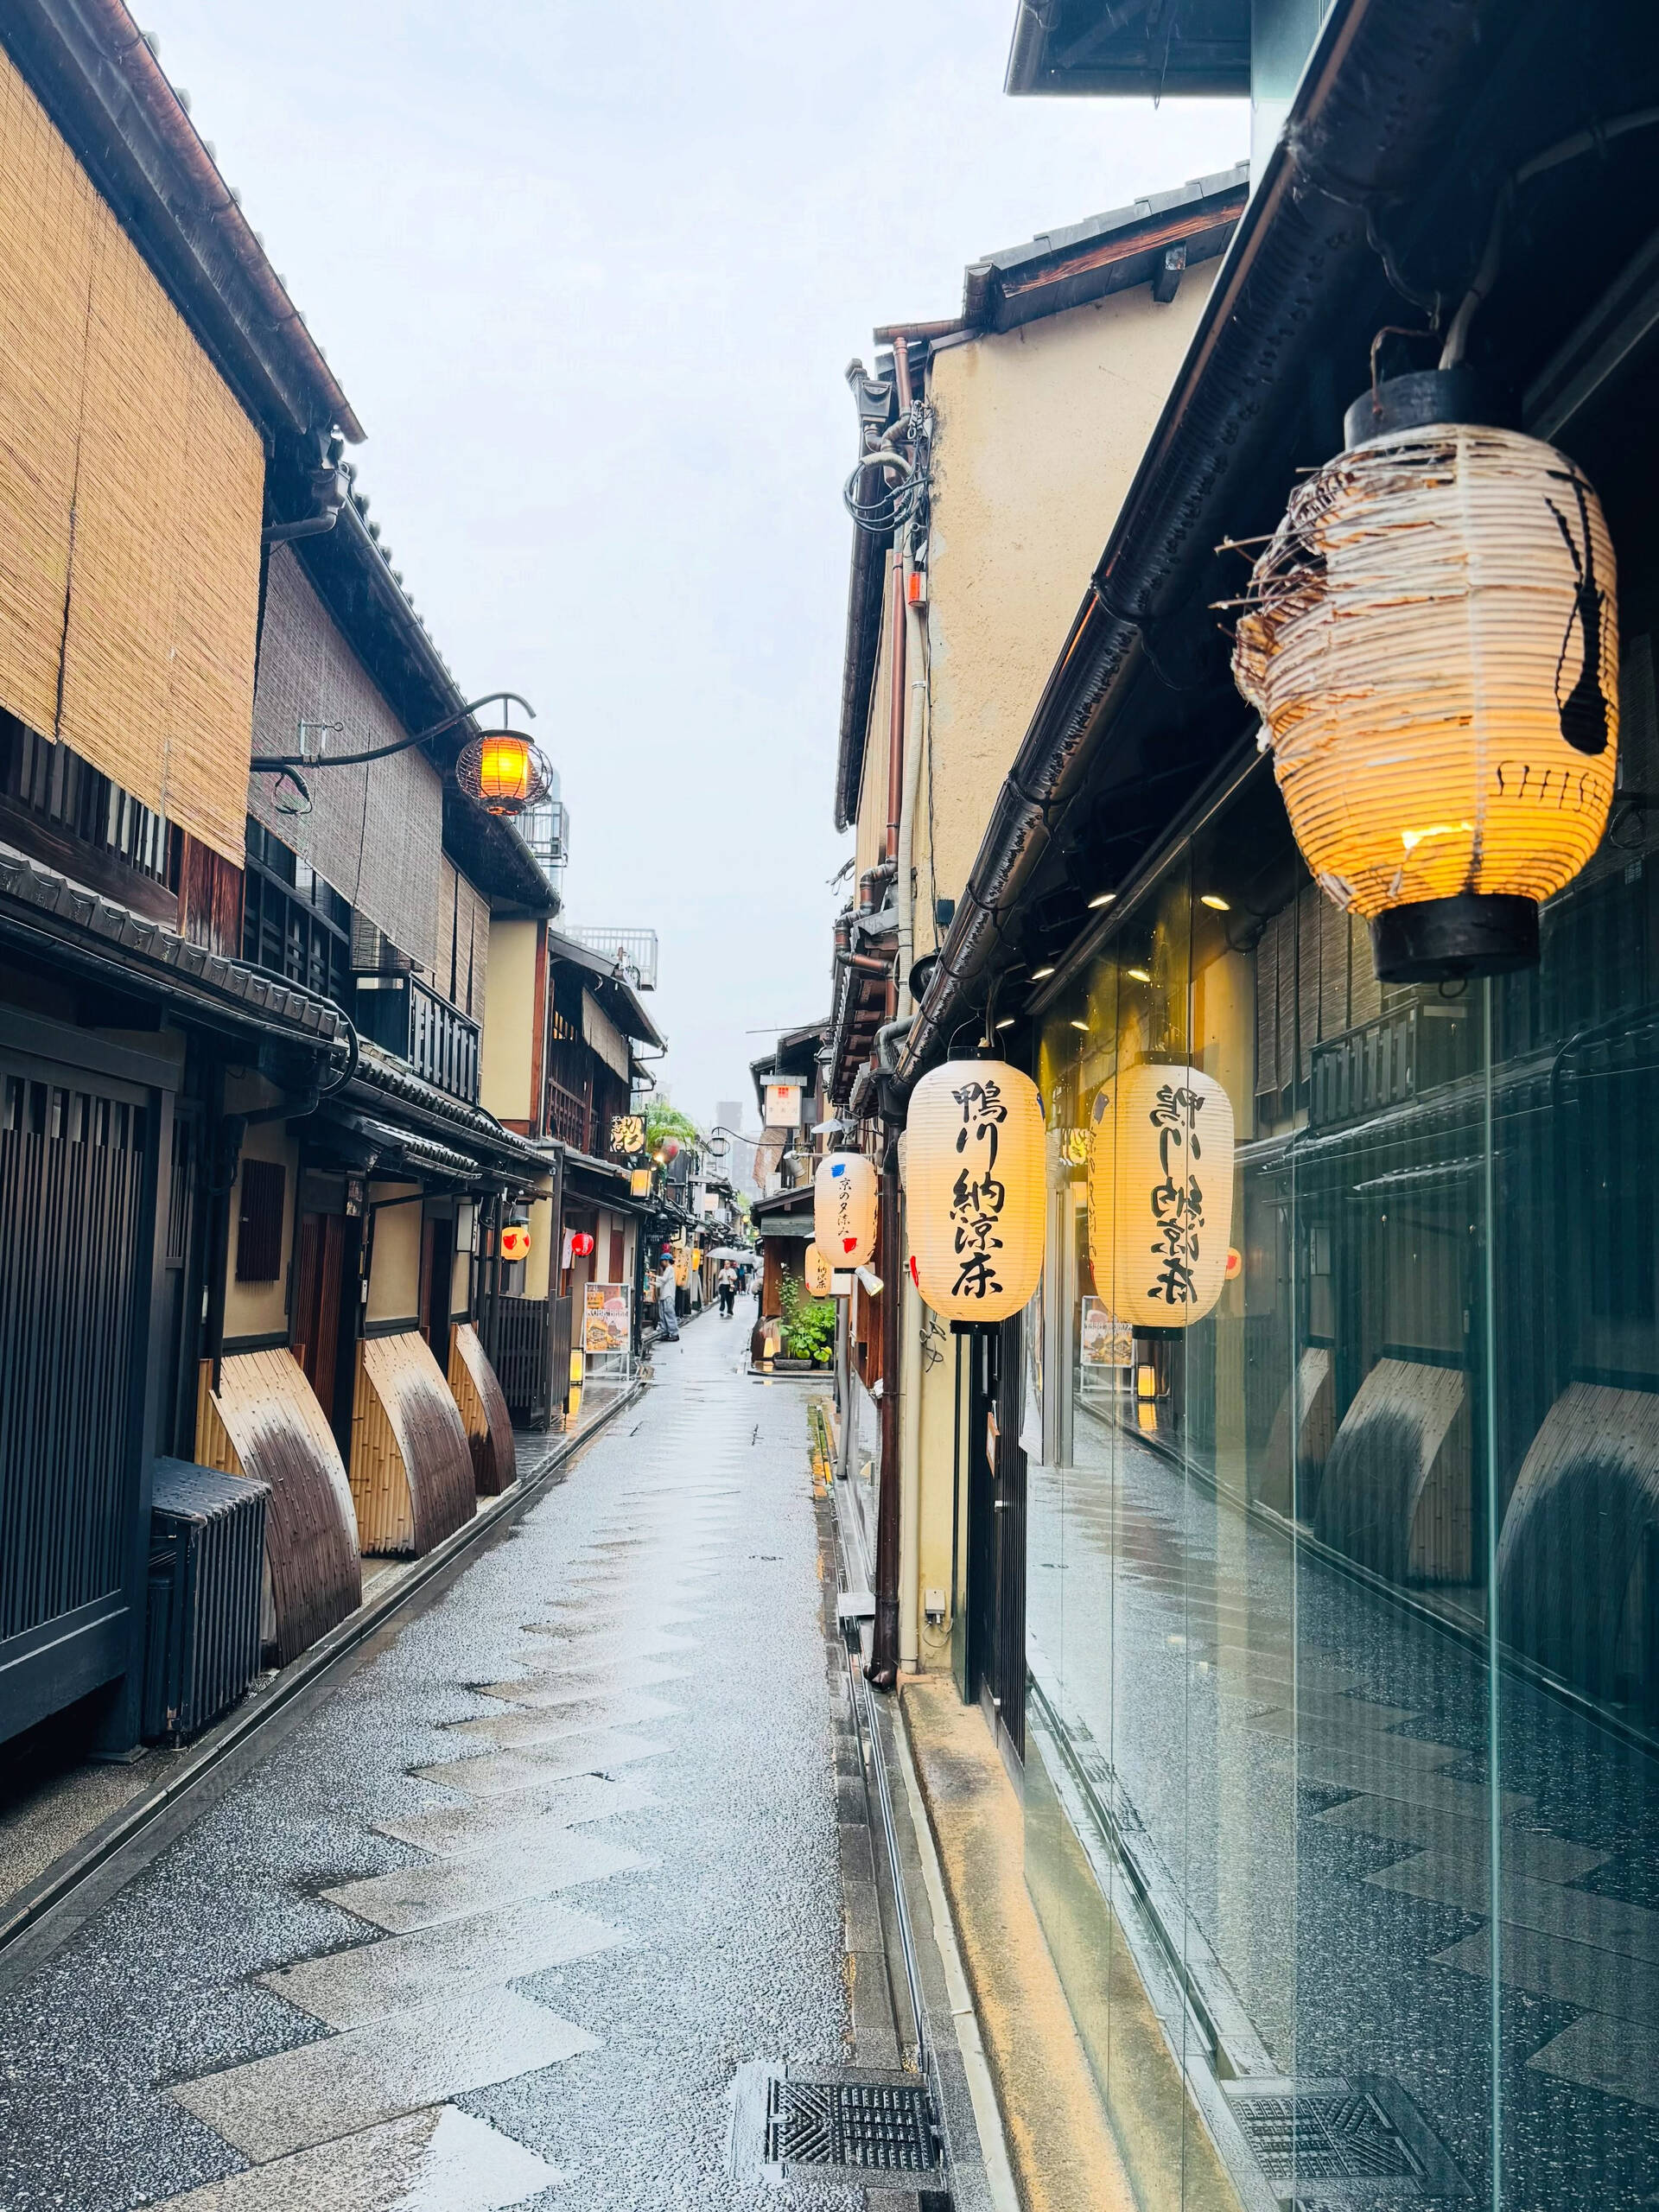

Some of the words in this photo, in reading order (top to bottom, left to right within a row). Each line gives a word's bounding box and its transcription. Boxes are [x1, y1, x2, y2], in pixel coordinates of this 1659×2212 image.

[950, 1080, 1007, 1299] 鴨川納涼床
